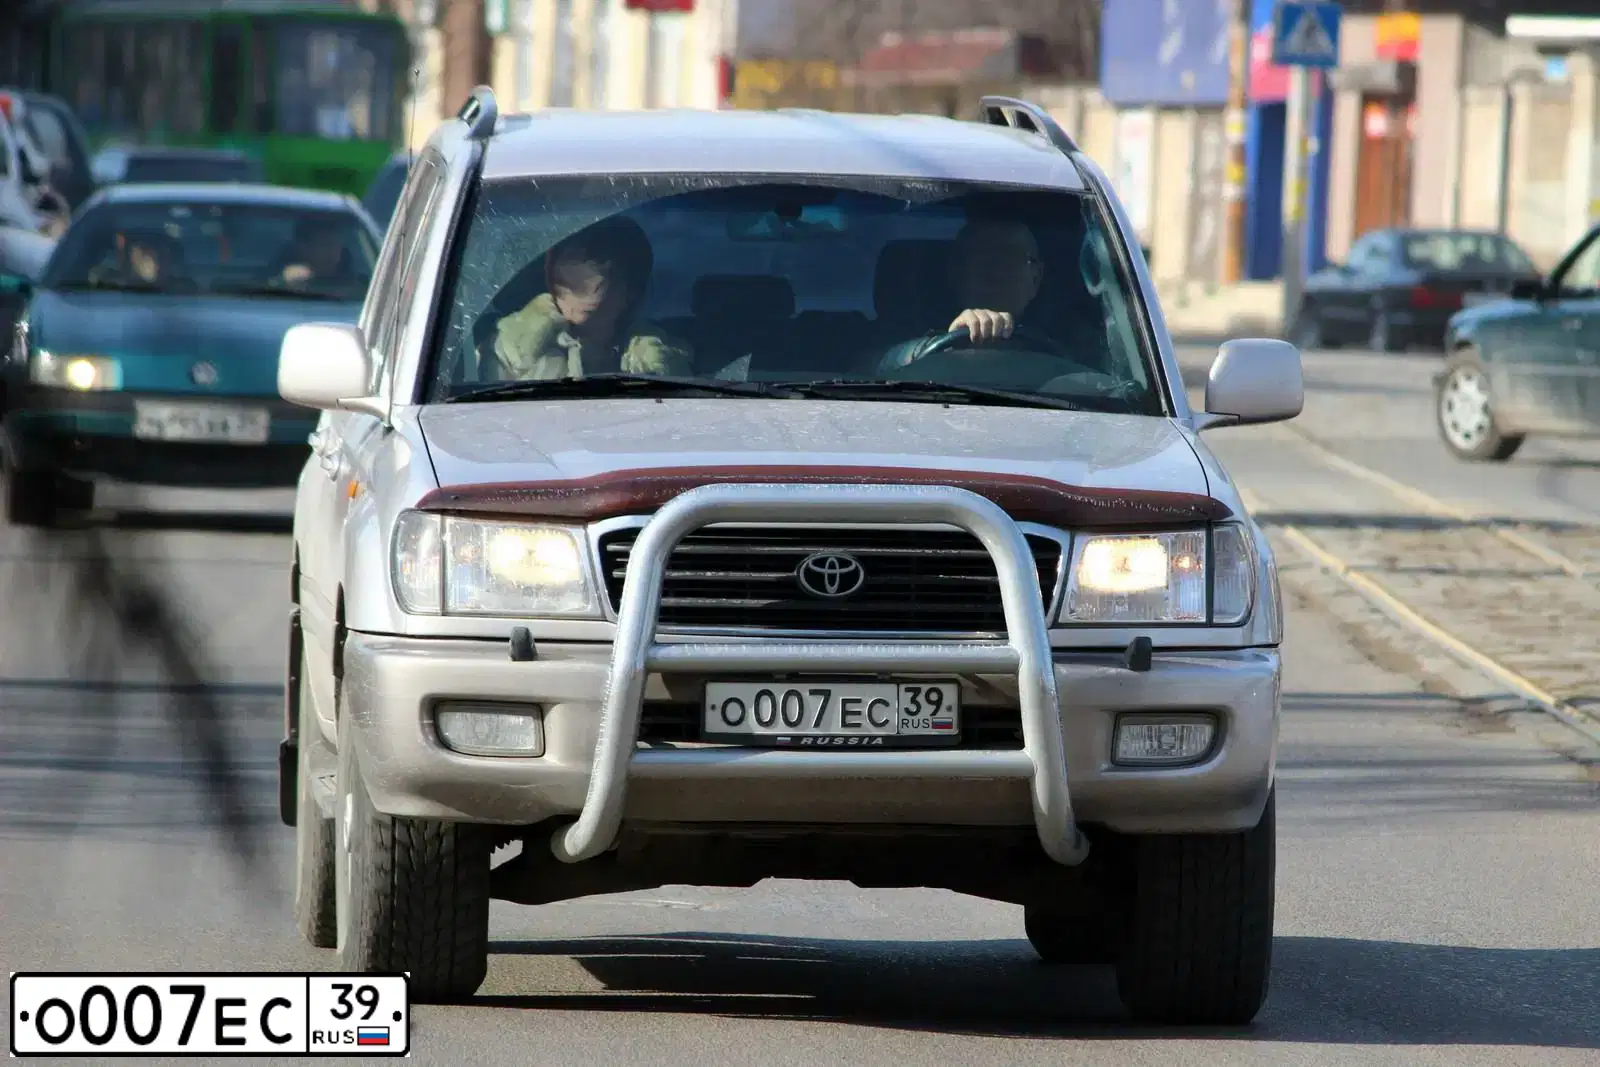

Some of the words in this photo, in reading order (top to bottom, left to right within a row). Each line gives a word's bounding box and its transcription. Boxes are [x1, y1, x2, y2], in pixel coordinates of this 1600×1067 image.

[903, 686, 944, 716] 39
[901, 718, 930, 729] RUS
[800, 736, 884, 745] RUSSIA
